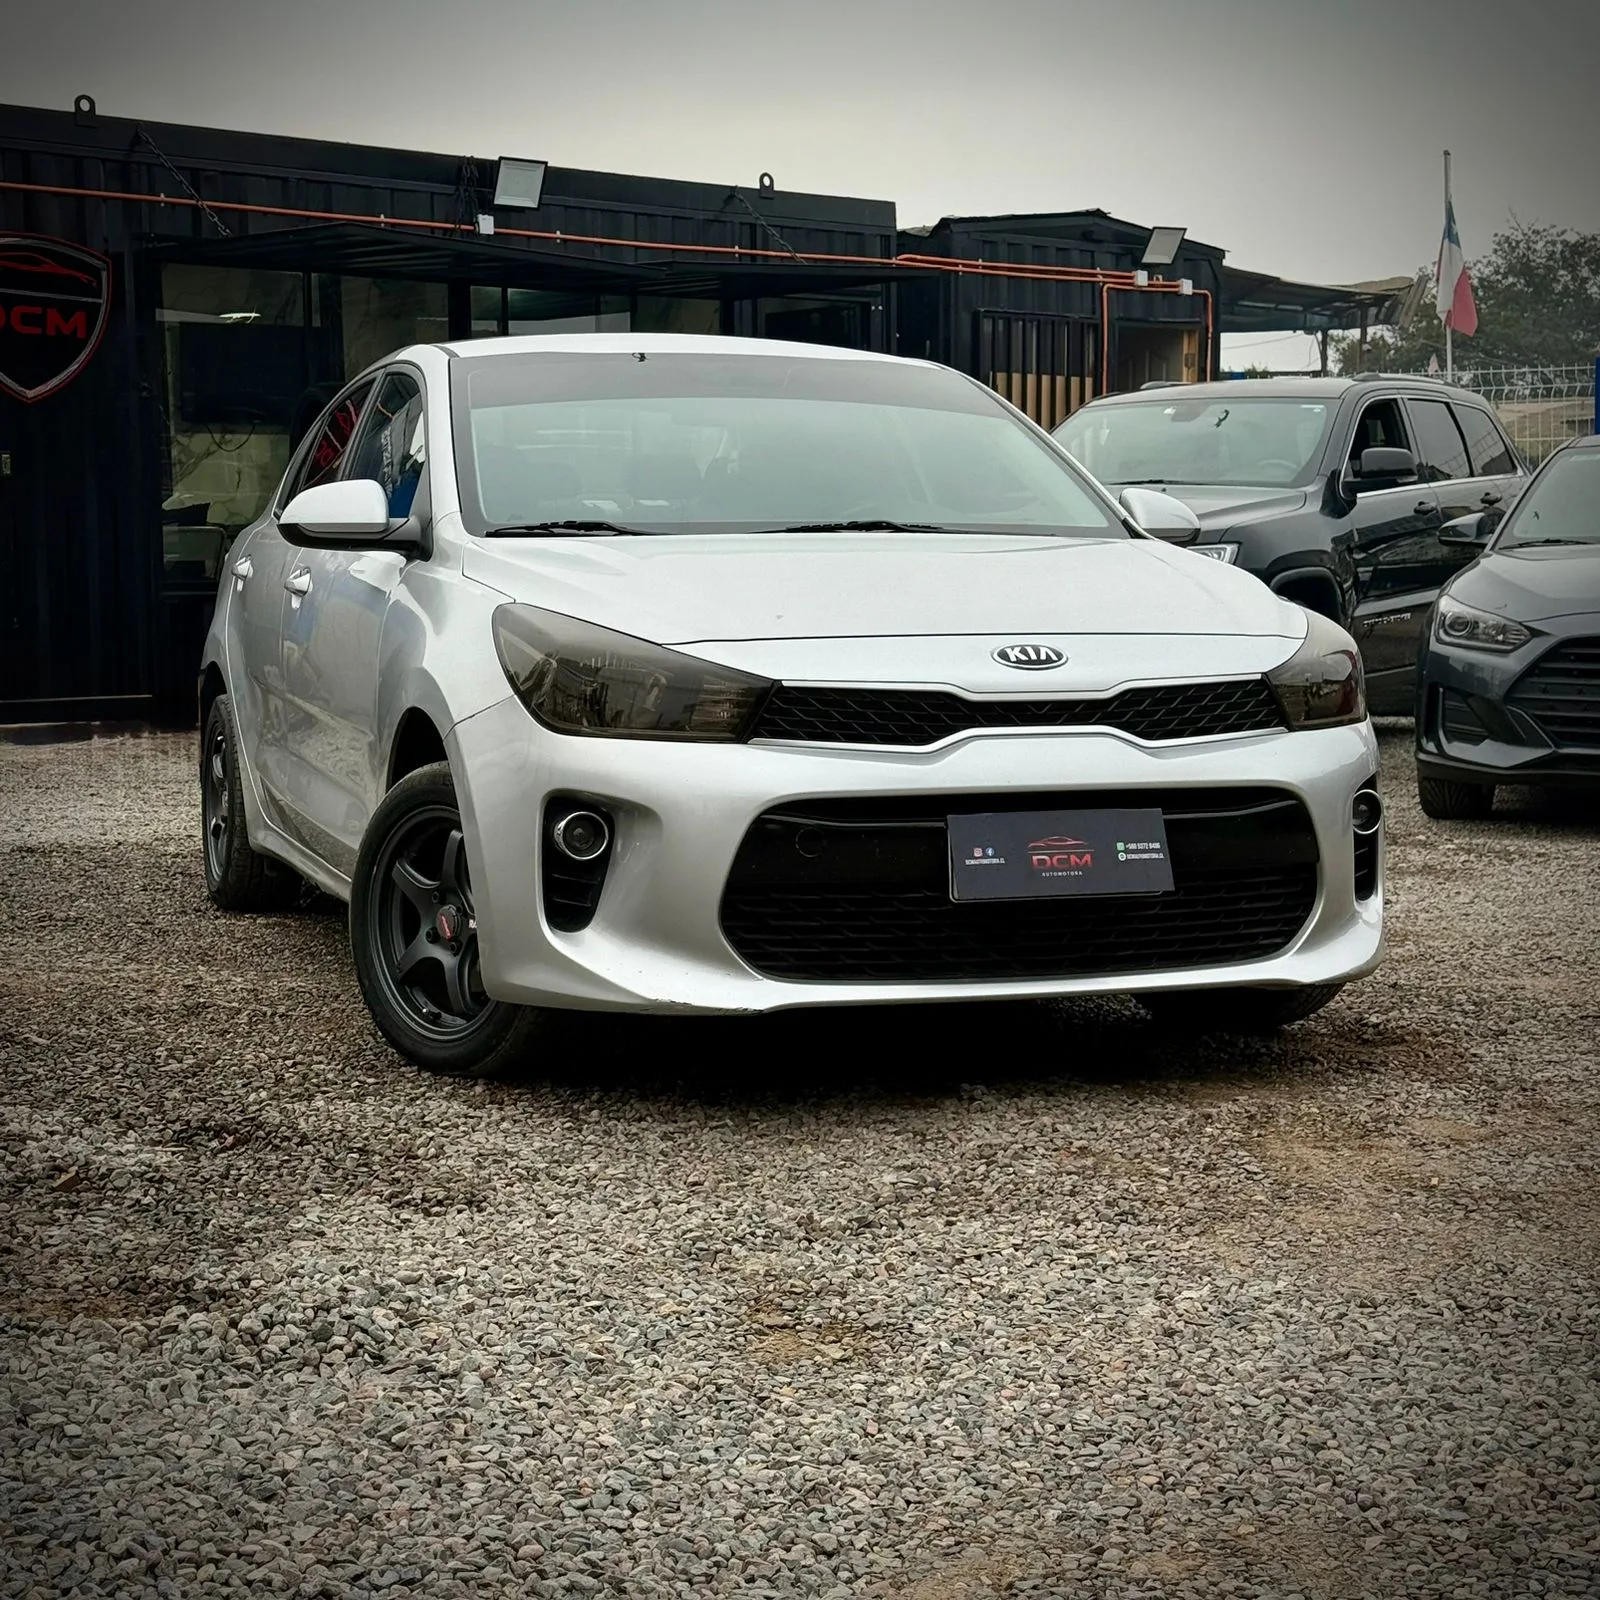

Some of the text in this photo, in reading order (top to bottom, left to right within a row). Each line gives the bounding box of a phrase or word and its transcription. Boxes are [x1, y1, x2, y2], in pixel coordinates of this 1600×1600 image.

[0, 304, 87, 338] CM
[1004, 646, 1059, 662] KIA
[1032, 853, 1092, 869] DCM
